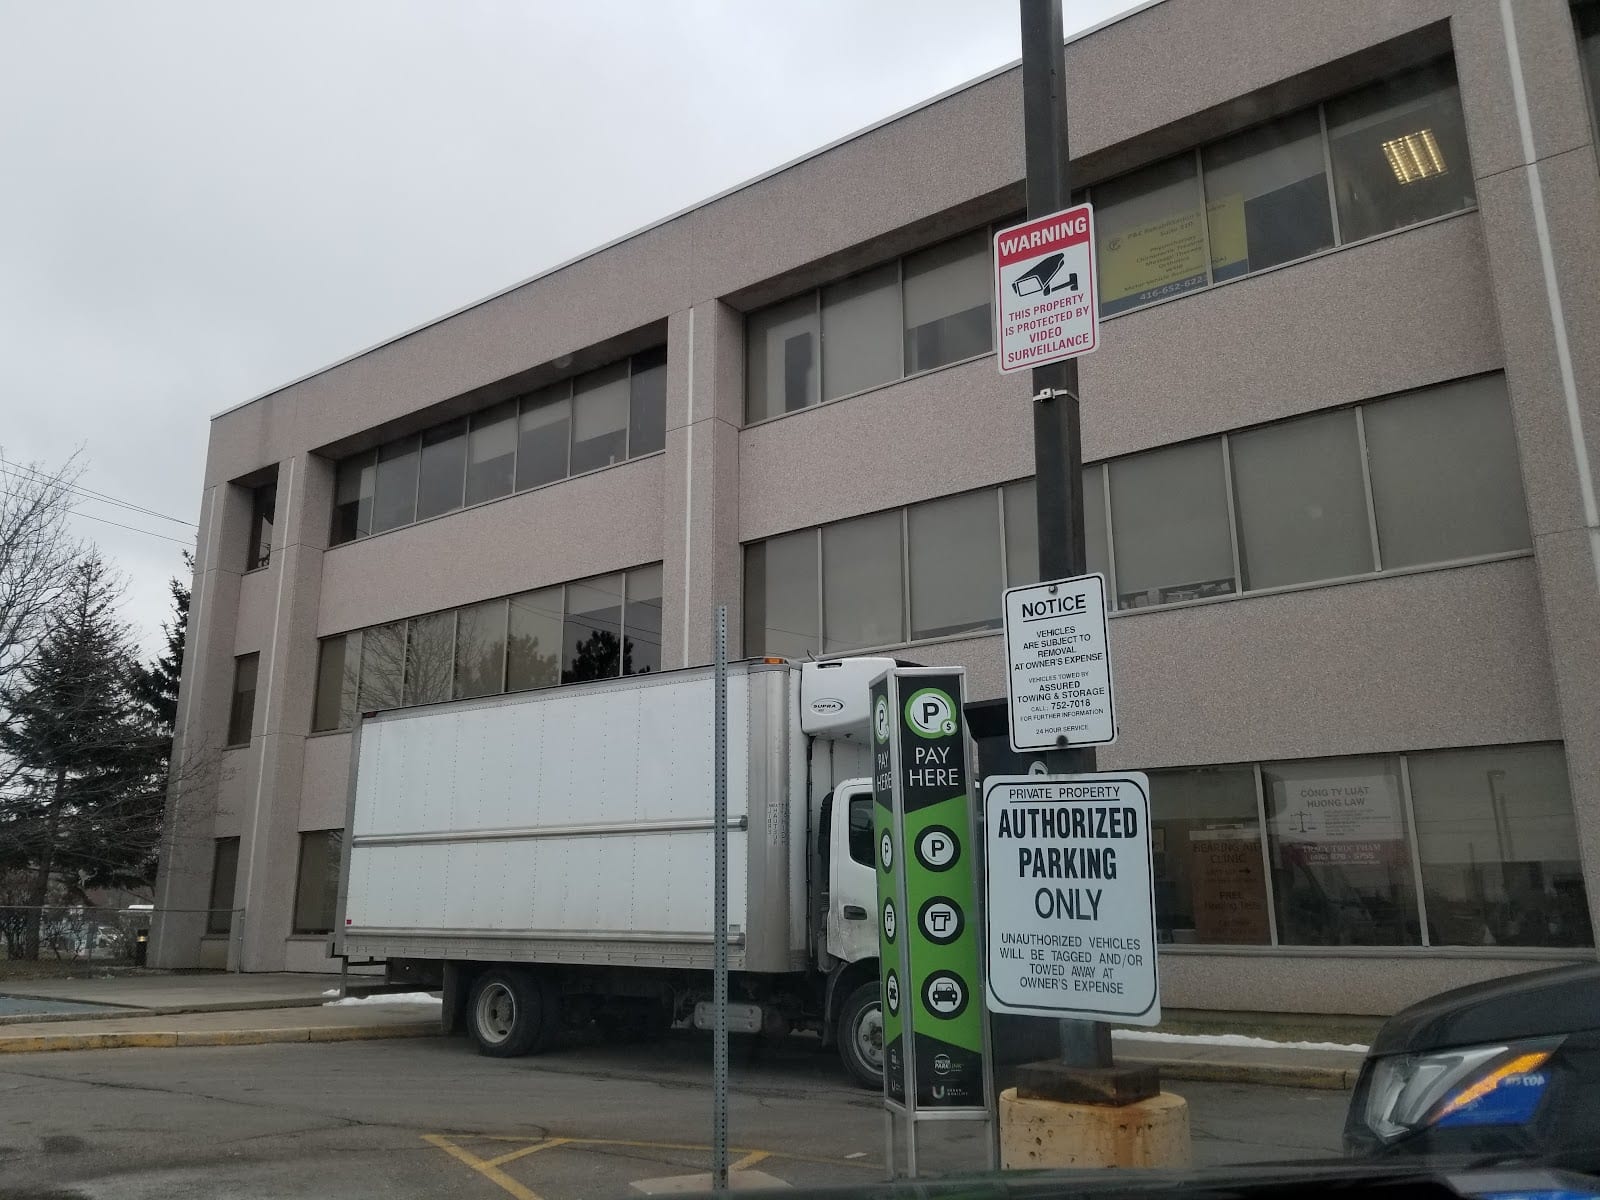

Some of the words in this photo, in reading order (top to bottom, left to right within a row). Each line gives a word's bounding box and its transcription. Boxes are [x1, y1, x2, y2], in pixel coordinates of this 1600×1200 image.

[1000, 216, 1087, 256] WARNING
[1009, 308, 1030, 322] THIS
[1033, 293, 1084, 315] PROPERTY
[1005, 326, 1014, 337] IS
[1017, 311, 1073, 334] PROTECTED
[1077, 305, 1089, 318] BY
[1029, 326, 1062, 343] VIDEO
[1008, 332, 1089, 363] SURVEILLANCE
[1022, 594, 1086, 618] NOTICE
[1036, 626, 1076, 638] VEHICLES
[1023, 640, 1039, 650] ARE
[1041, 635, 1078, 648] SUBJECT
[1079, 633, 1091, 642] TO
[1037, 645, 1076, 658] REMOVAL
[1014, 662, 1025, 671] AT
[1025, 656, 1063, 670] OWNER'S
[1065, 652, 1103, 665] EXPENSE
[1029, 674, 1057, 683] VEHICLES
[1058, 671, 1080, 680] TOWED
[1039, 680, 1081, 692] ASSURED
[1017, 692, 1051, 703] TOWING
[1054, 692, 1060, 700] &
[1062, 687, 1105, 699] STORAGE
[1051, 698, 1091, 710] 752-7018
[922, 702, 940, 724] P
[1020, 714, 1032, 722] FOR
[1034, 712, 1061, 721] FURTHER
[1062, 708, 1104, 718] INFORMATION
[1045, 726, 1061, 734] HOUR
[1063, 724, 1089, 732] SERVICE
[877, 750, 889, 770] PAY
[915, 746, 950, 765] PAY
[876, 771, 892, 792] HERE
[909, 768, 959, 787] HERE
[1009, 788, 1052, 799] PRIVATE
[1059, 786, 1120, 798] PROPERTY
[998, 807, 1138, 839] AUTHORIZED
[931, 839, 945, 857] P
[1018, 847, 1117, 880] PARKING
[1034, 887, 1103, 921] ONLY
[1001, 933, 1082, 948] UNAUTHORIZED
[1088, 936, 1141, 950] VEHICLES
[999, 948, 1024, 960] WILL
[1030, 949, 1045, 961] BE
[1050, 950, 1092, 963] TAGGED
[1099, 953, 1143, 968] AND/OR
[1029, 963, 1064, 976] TOWED
[1071, 966, 1096, 979] AWAY
[1102, 967, 1115, 979] AT
[1020, 977, 1068, 991] OWNER'S
[1074, 980, 1124, 995] EXPENSE
